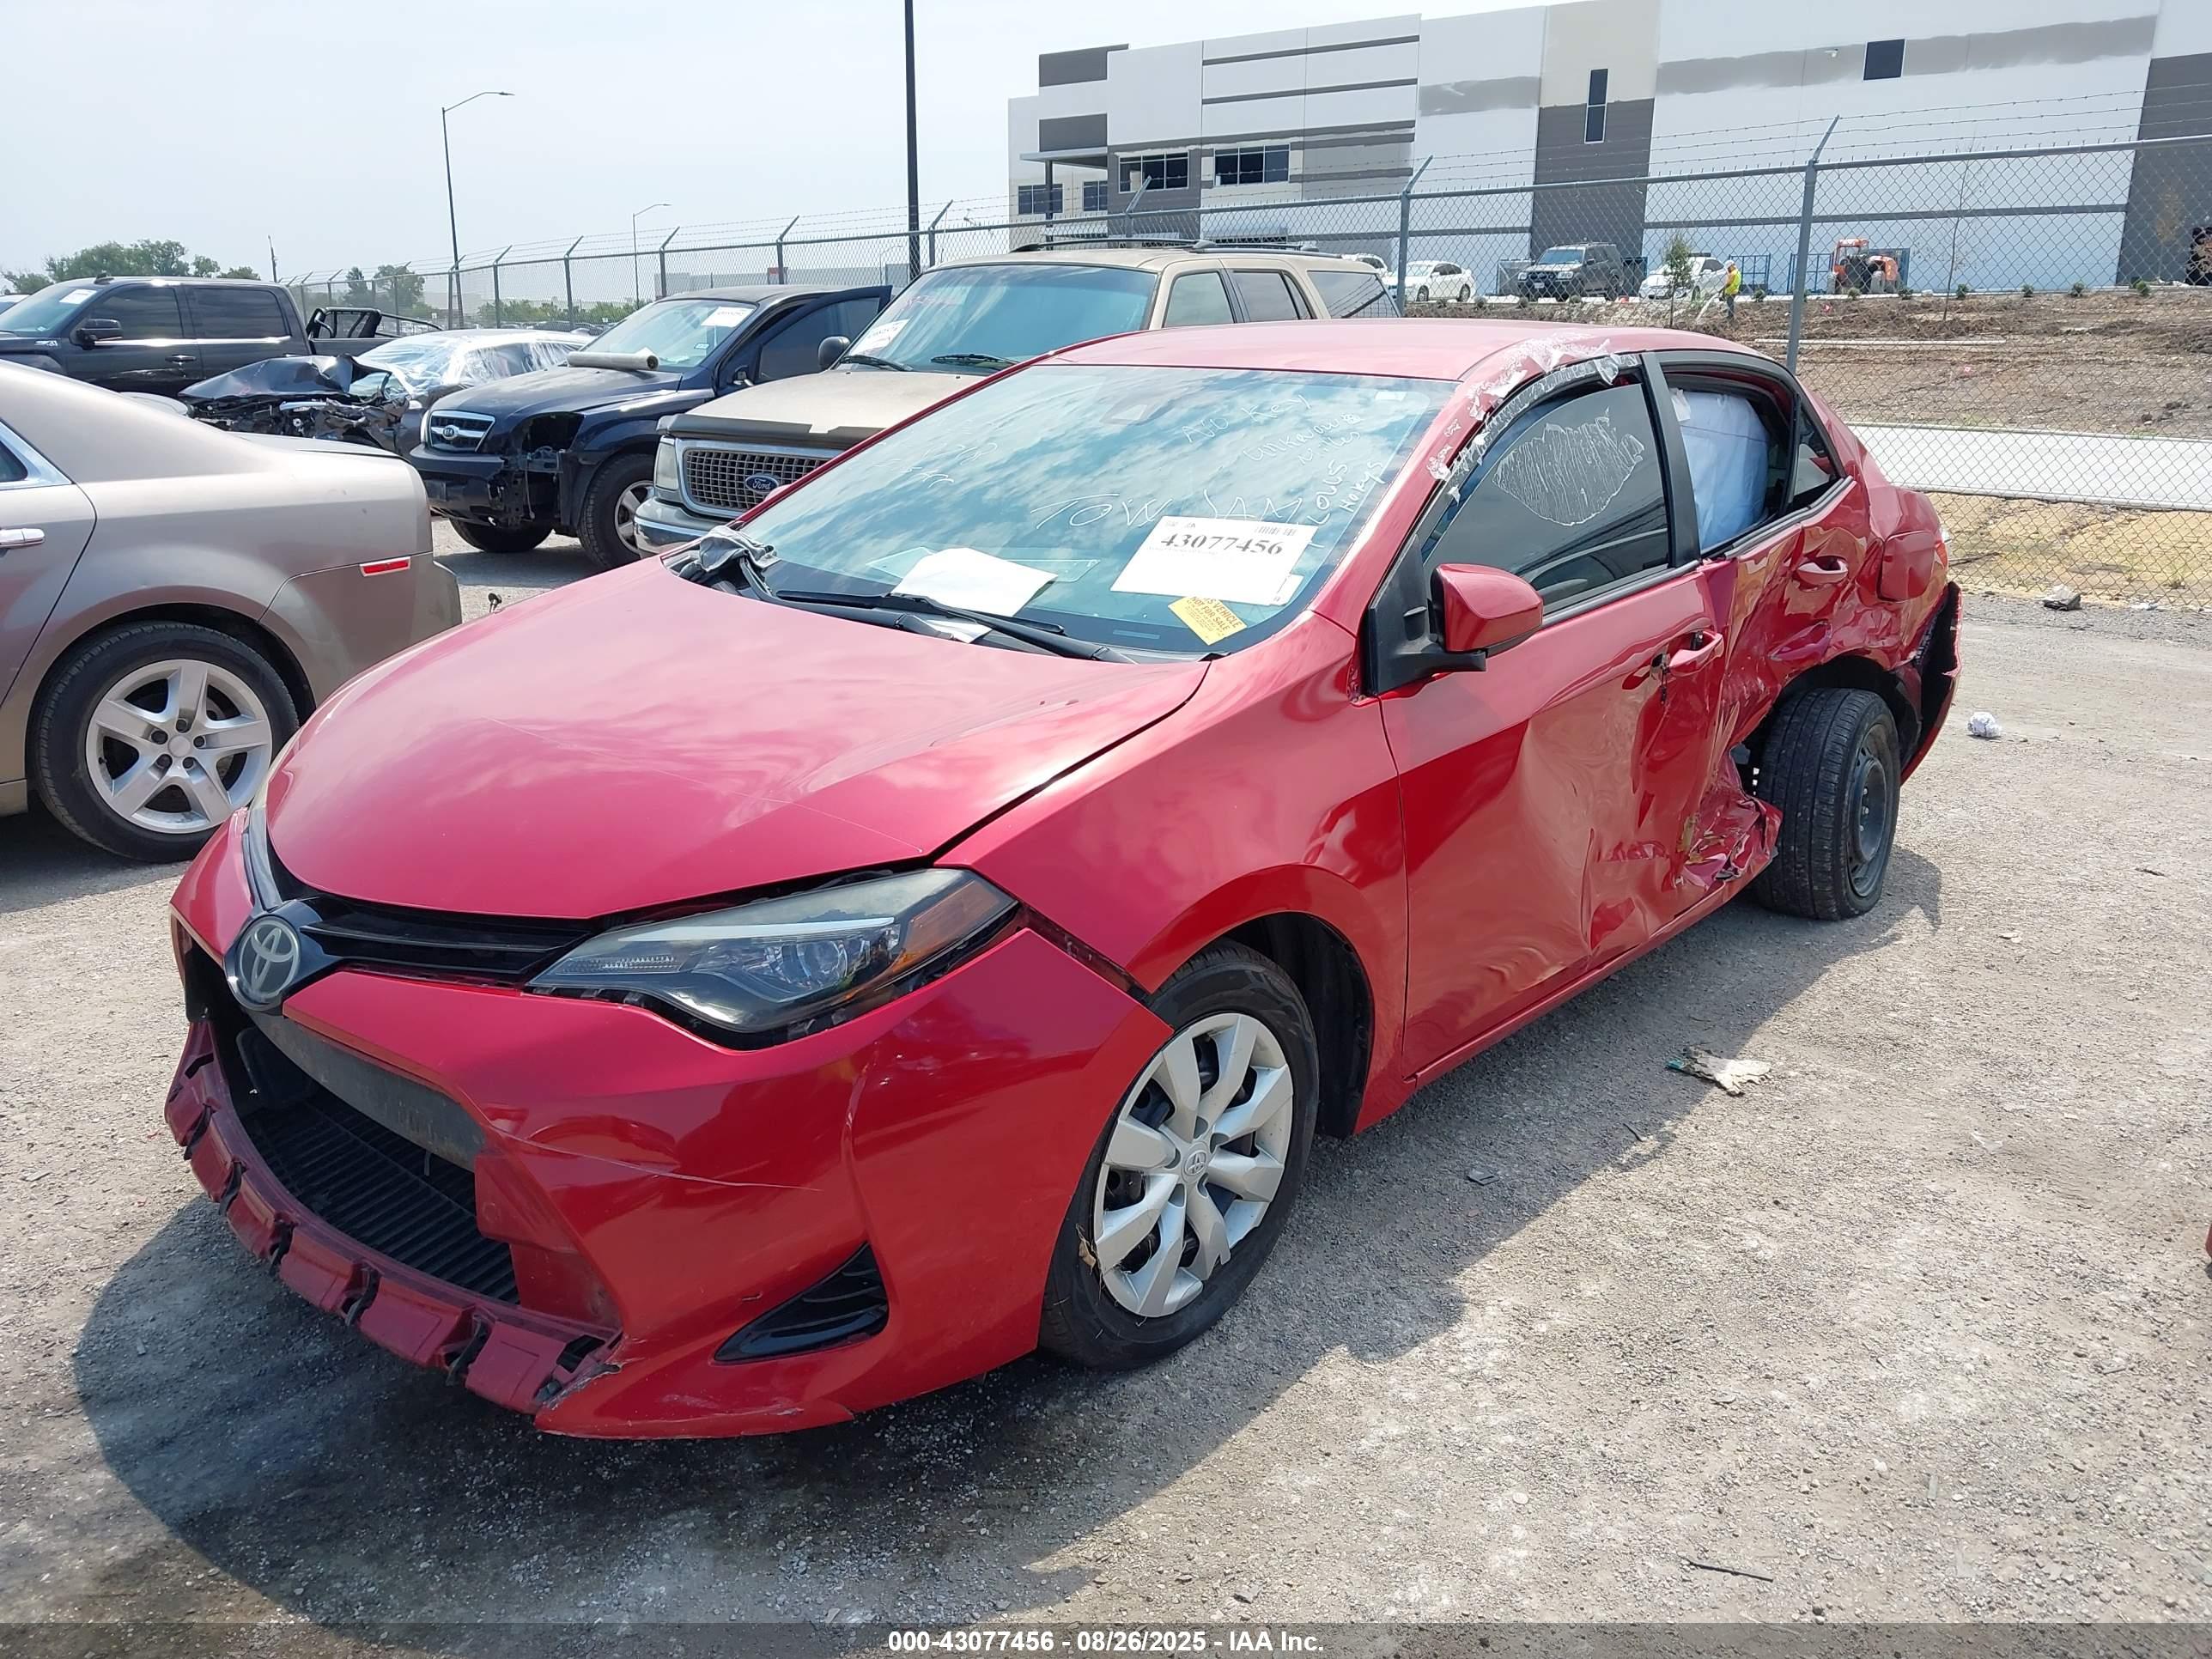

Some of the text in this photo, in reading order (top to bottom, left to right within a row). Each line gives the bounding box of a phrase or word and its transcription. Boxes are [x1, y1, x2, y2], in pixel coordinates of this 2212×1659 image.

[1160, 532, 1285, 556] 43077456
[1202, 606, 1215, 618] FOR
[1212, 617, 1231, 630] SALE
[1212, 601, 1243, 629] VEHICLE
